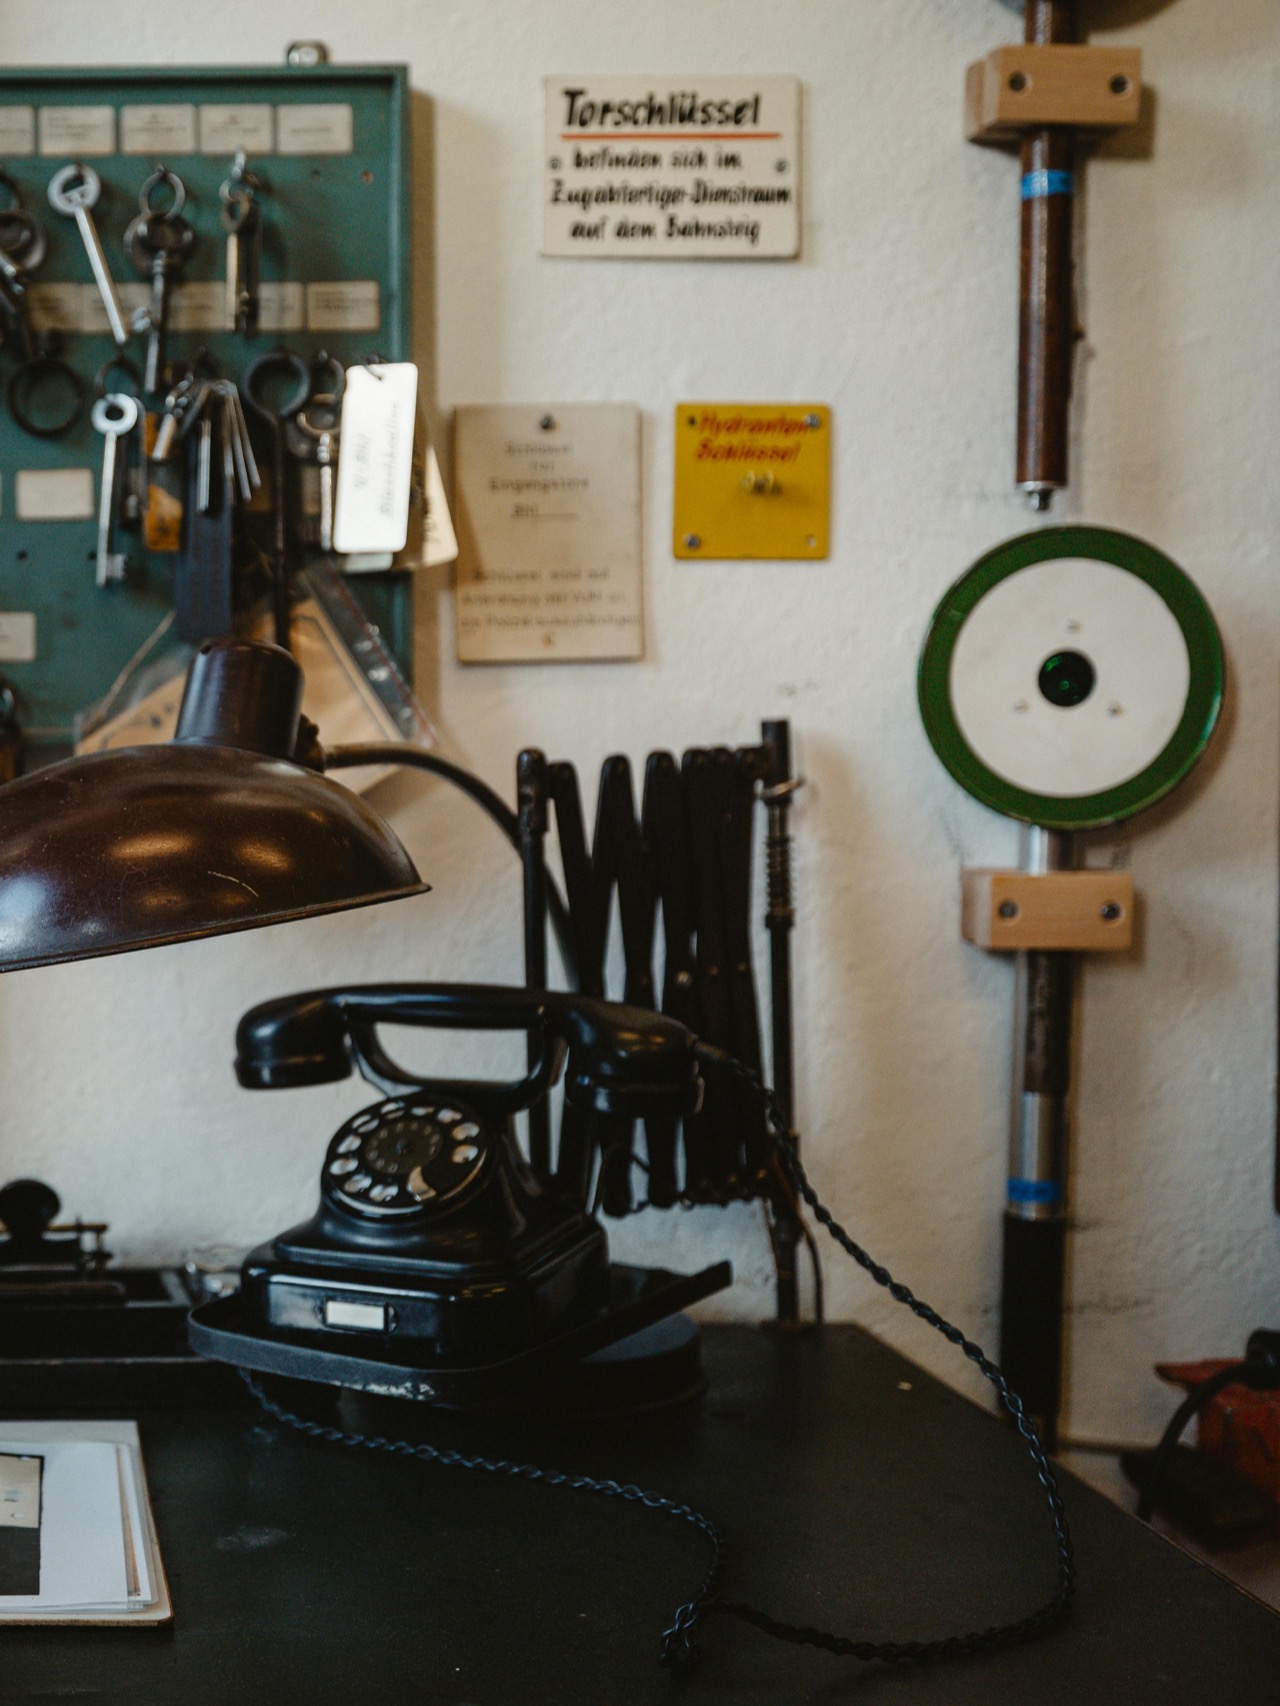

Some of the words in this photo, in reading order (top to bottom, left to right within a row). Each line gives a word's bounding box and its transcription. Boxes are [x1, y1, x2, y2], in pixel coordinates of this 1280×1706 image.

[563, 86, 762, 127] Torschlüssel
[573, 145, 663, 170] befinden
[671, 146, 708, 169] sich
[715, 145, 743, 169] im
[570, 214, 608, 239] auf
[616, 216, 657, 239] dem
[666, 212, 762, 245] Bahnsteig
